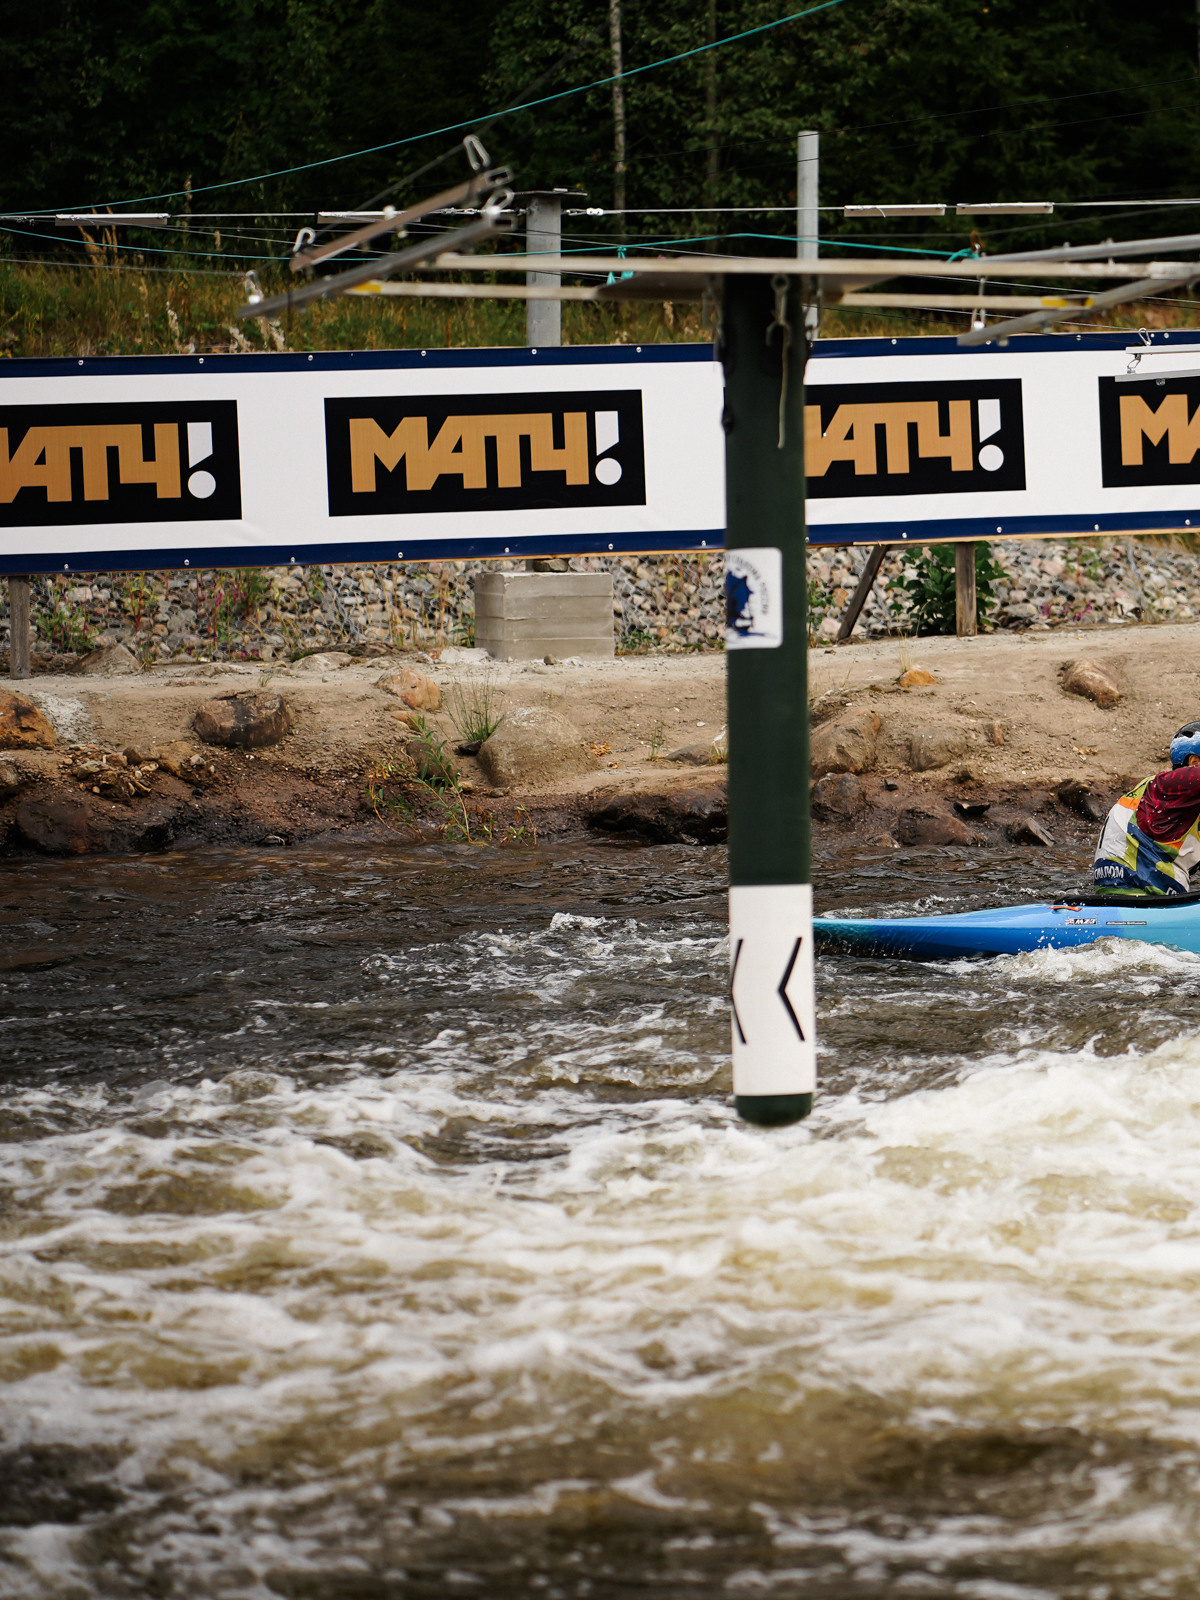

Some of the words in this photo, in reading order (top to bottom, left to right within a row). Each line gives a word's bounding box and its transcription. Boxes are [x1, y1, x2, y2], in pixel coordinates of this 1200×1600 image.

[0, 421, 216, 504] АТЧ!
[349, 410, 623, 494] МАТЧ!
[803, 398, 1005, 478] АТЧ!
